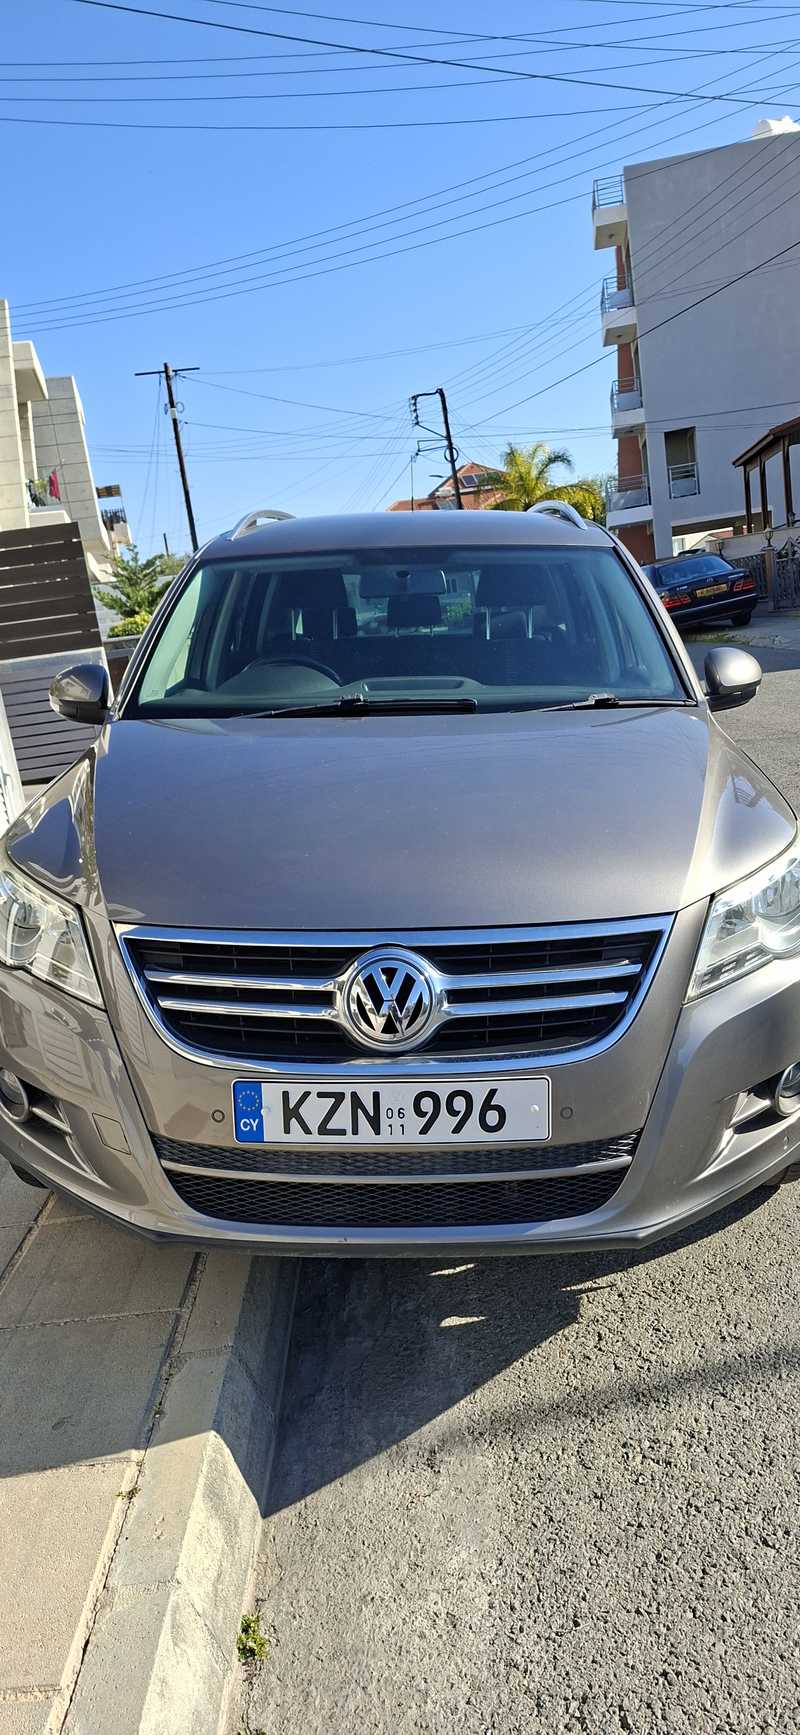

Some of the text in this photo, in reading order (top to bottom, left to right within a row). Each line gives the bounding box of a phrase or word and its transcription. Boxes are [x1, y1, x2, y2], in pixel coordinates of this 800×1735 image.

[348, 957, 432, 1043] VW
[282, 1088, 507, 1136] KZN 996
[386, 1107, 405, 1120] 06
[240, 1118, 259, 1131] CY
[387, 1123, 405, 1135] 11
